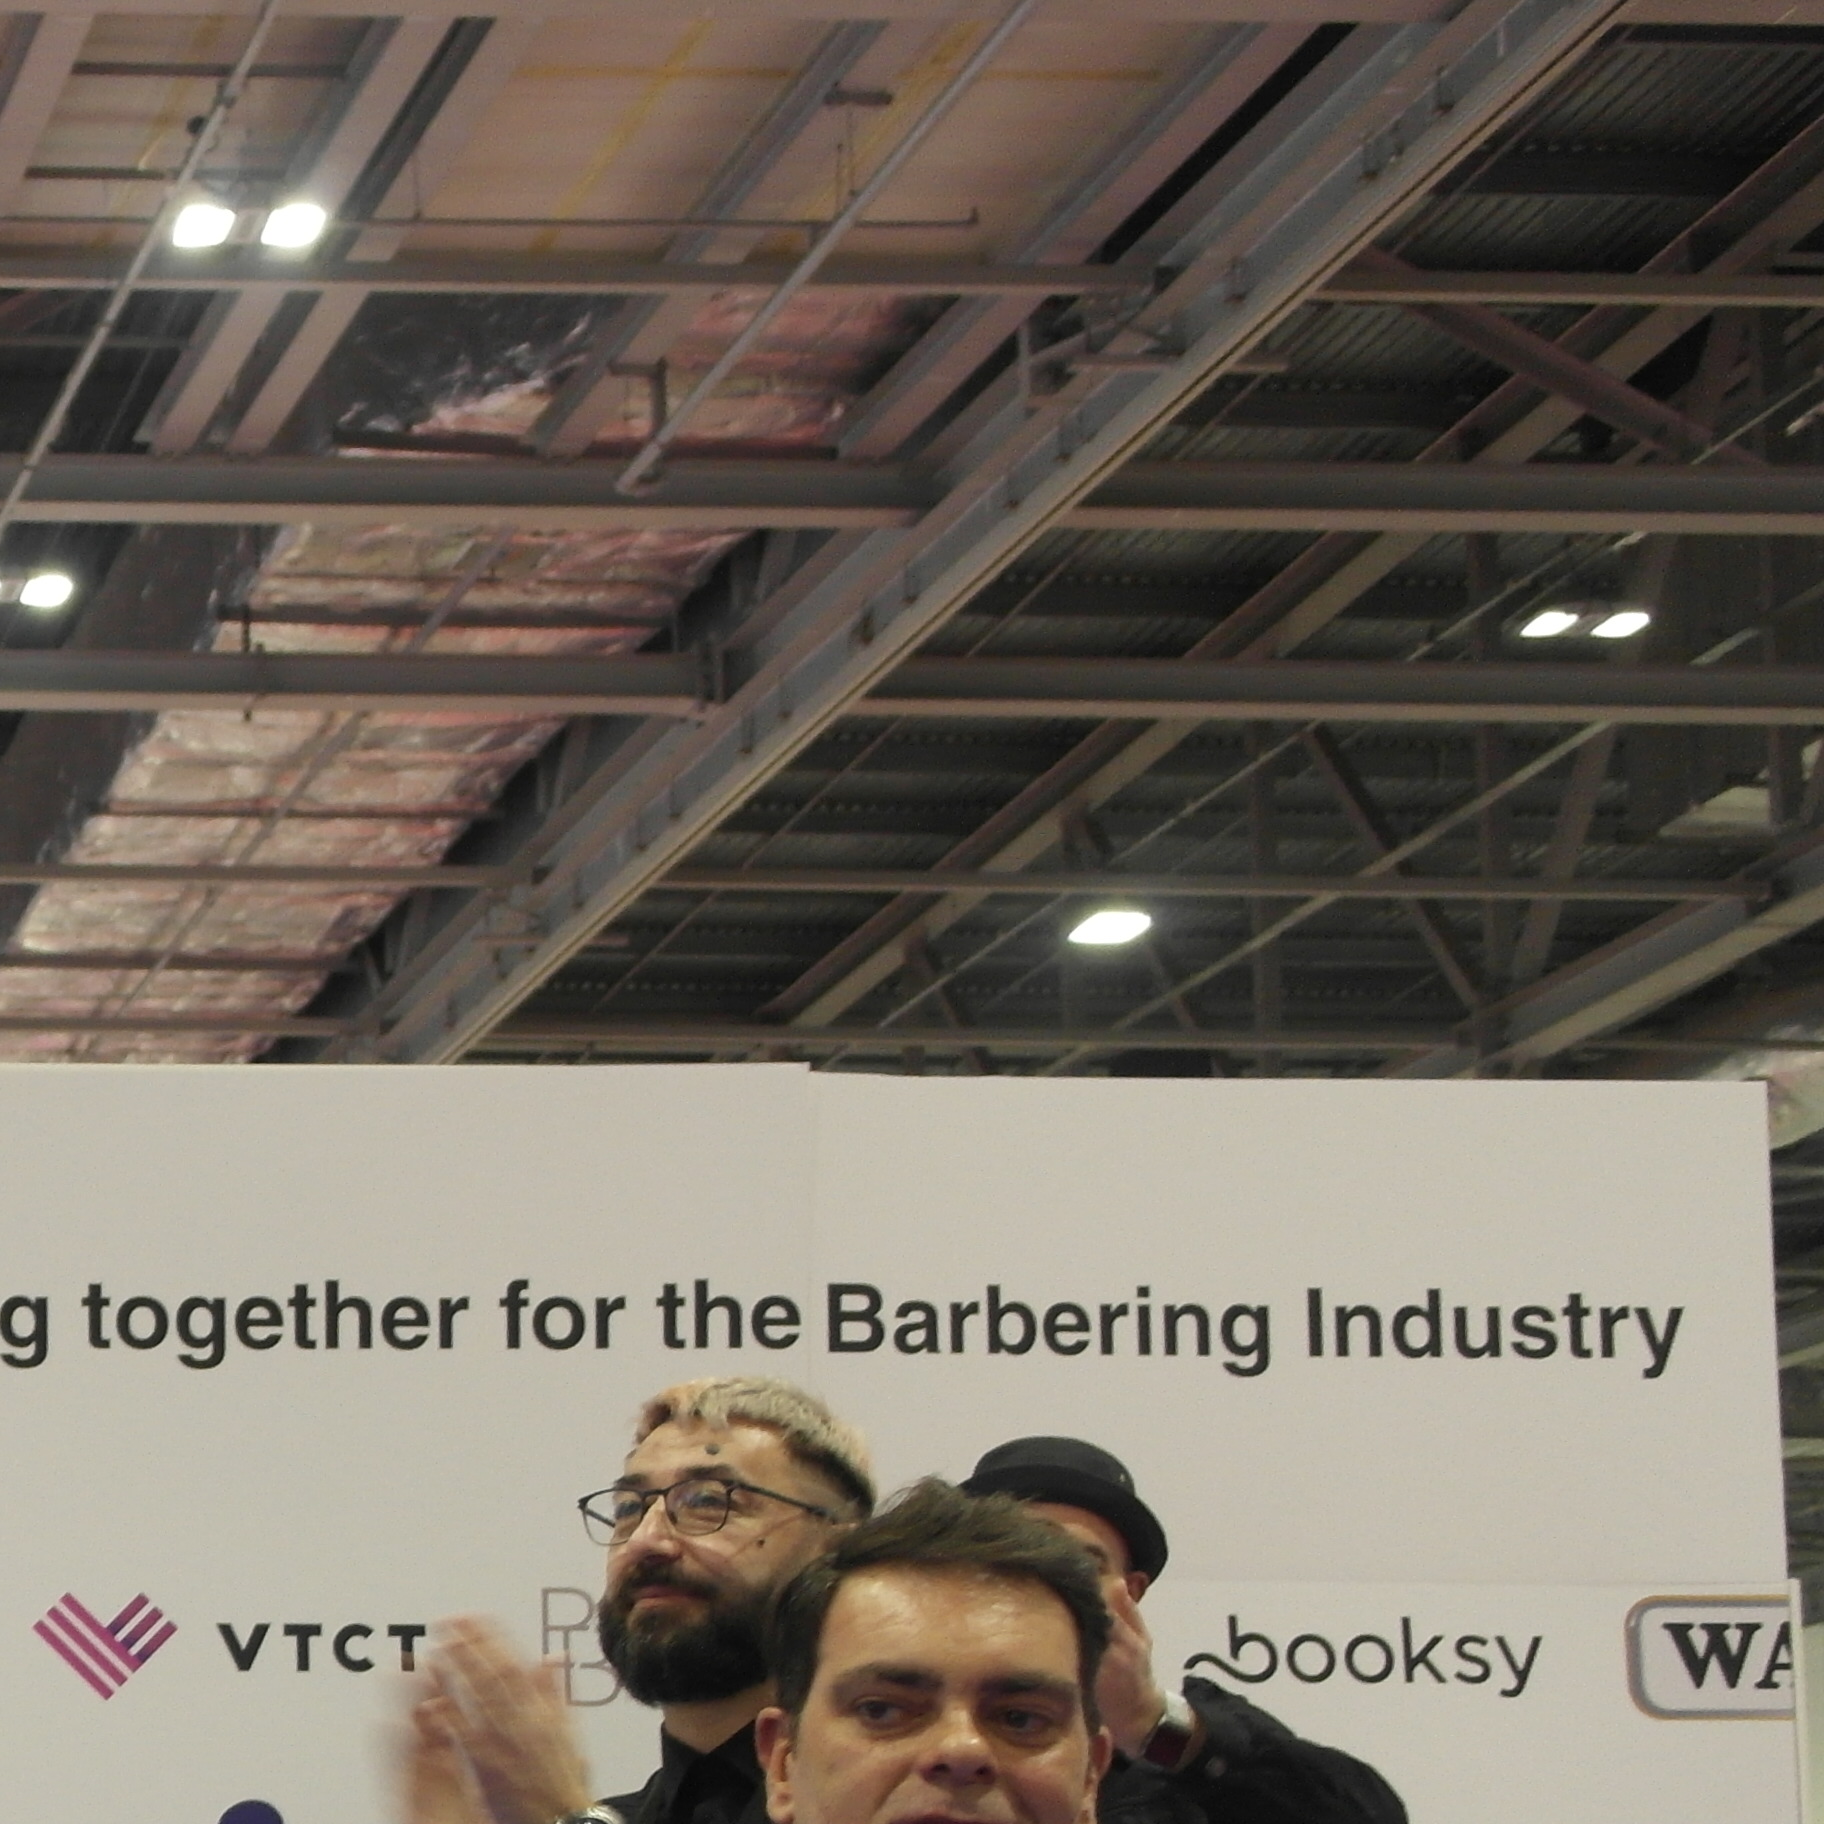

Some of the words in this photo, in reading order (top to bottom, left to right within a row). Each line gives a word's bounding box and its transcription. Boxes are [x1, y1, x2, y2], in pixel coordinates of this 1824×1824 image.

[82, 1278, 469, 1370] together
[498, 1278, 625, 1351] for
[655, 1278, 801, 1351] the
[826, 1282, 1271, 1377] Barbering
[1306, 1287, 1684, 1380] Industry
[217, 1623, 427, 1672] VTCT
[1184, 1615, 1542, 1697] booksy
[1663, 1621, 1792, 1690] WA
